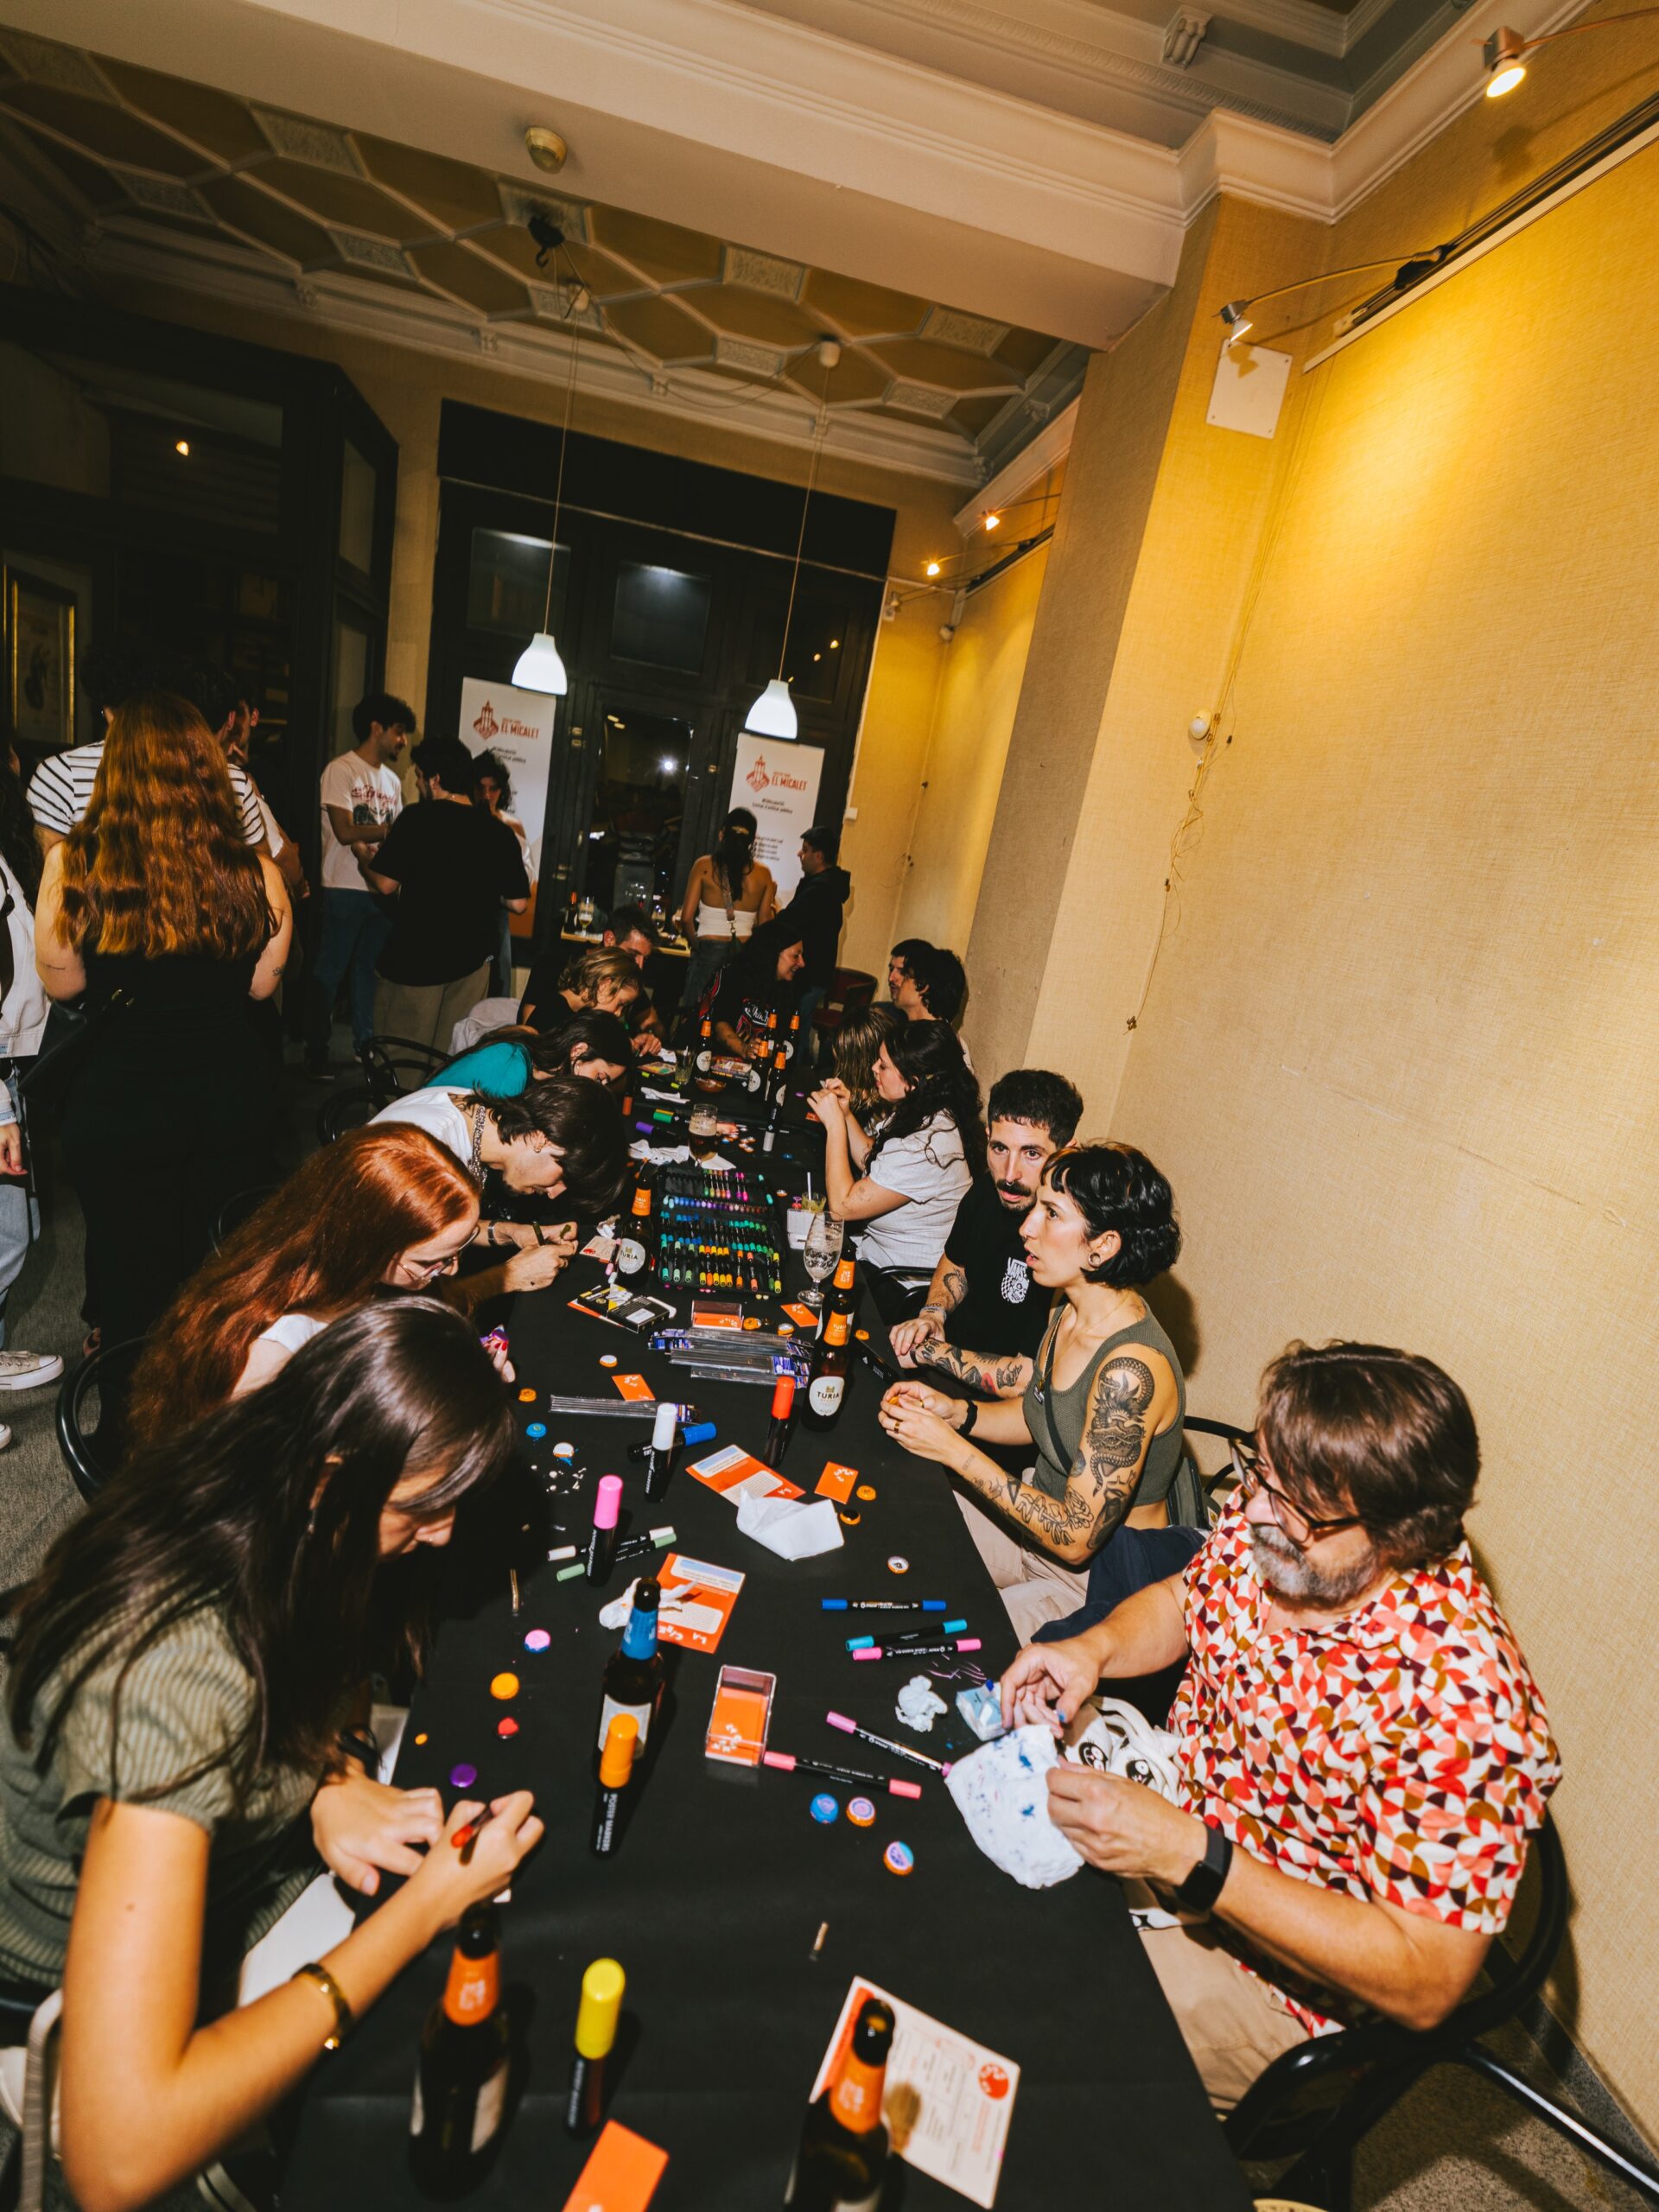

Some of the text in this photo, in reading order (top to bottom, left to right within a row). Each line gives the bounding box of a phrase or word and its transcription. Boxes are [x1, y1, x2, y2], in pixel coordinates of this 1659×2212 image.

[501, 723, 539, 739] EL MICALET
[772, 775, 806, 791] EL MICALET
[620, 1249, 638, 1261] TURIA
[692, 1631, 708, 1644] LA
[601, 1793, 618, 1852] POSTER MARKERS
